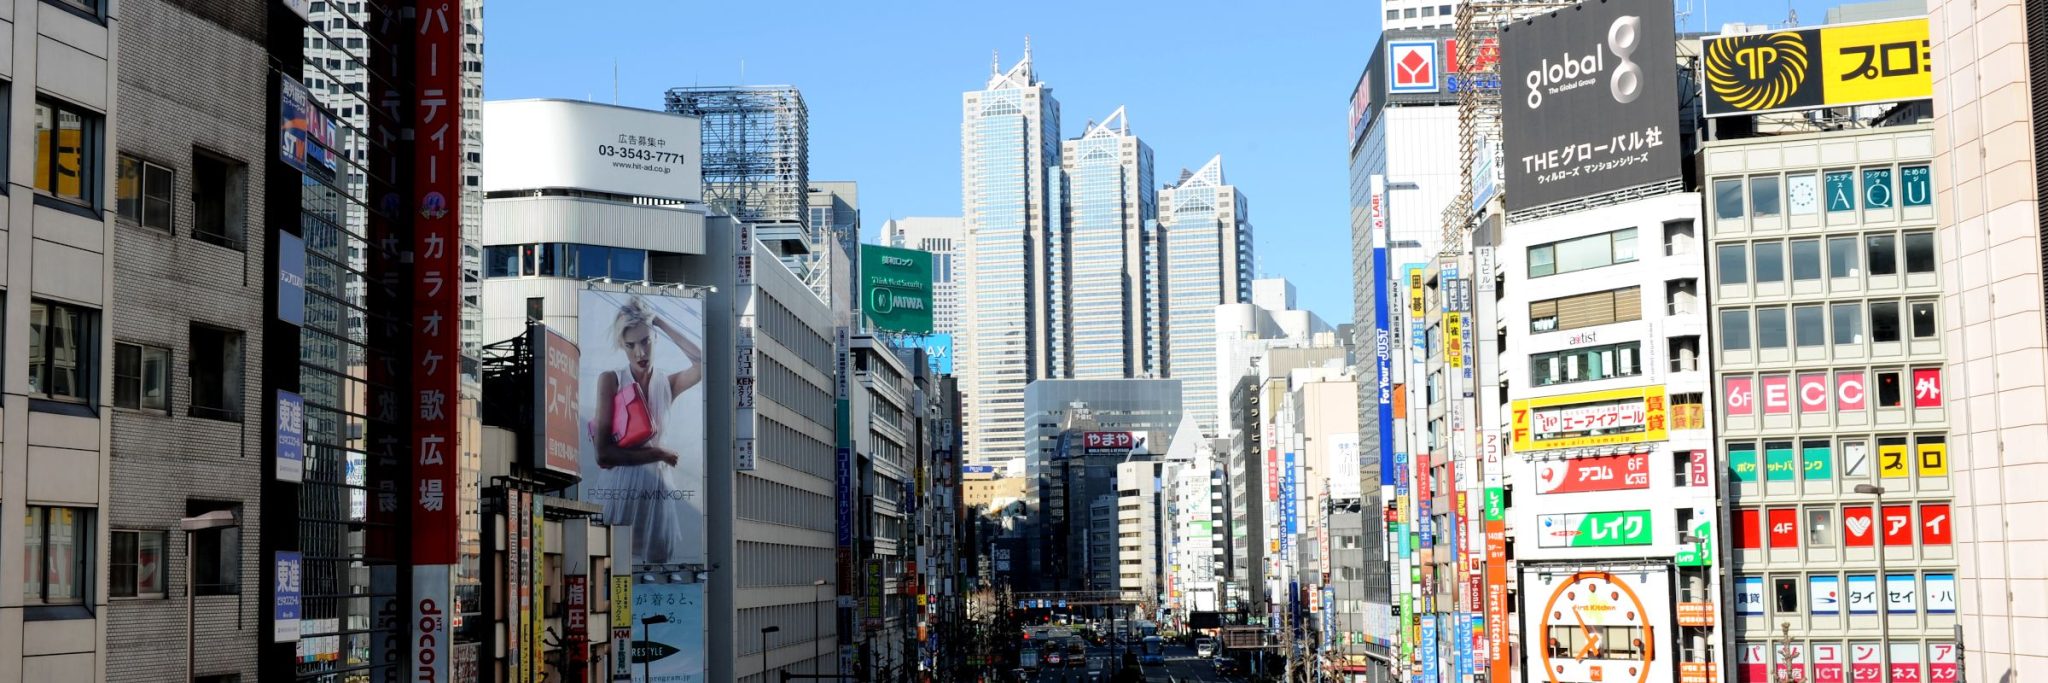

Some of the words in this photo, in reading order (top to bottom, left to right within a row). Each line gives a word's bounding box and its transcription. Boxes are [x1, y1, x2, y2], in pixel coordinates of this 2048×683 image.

[1526, 43, 1603, 109] global
[1548, 87, 1559, 95] The
[1560, 81, 1578, 92] Global
[1579, 78, 1597, 88] Group
[420, 3, 449, 184] パーティー
[618, 133, 666, 149] 広告募集中
[1522, 125, 1663, 174] THEグローバル社
[598, 144, 685, 165] 03-3543-7771
[612, 160, 671, 174] www.hit-ad.co.jp
[1538, 166, 1580, 184] ウィルローズ
[1584, 152, 1649, 175] マンションシリーズ
[1480, 248, 1491, 284] 村上ビル
[892, 295, 924, 310] MIWA
[420, 233, 449, 512] カラオケ歌広場
[736, 377, 754, 386] KEN
[1380, 366, 1389, 388] Your
[1380, 388, 1390, 404] For
[1728, 386, 1753, 407] 6F
[1915, 377, 1940, 400] 外
[279, 399, 301, 435] 東進
[1250, 384, 1261, 455] ホウライビル
[1563, 410, 1645, 431] エーアイアール
[1646, 395, 1665, 432] 賃貸
[1514, 410, 1528, 443] 7F
[1087, 433, 1130, 446] やまや
[1488, 434, 1497, 463] アコム
[1578, 465, 1614, 482] アコム
[1627, 458, 1643, 472] 6F
[1694, 452, 1706, 484] アコム
[1489, 491, 1500, 517] レイク
[1590, 515, 1643, 541] レイク
[1773, 522, 1793, 534] 4F
[277, 560, 299, 592] 東進
[567, 583, 585, 629] 指圧
[1489, 584, 1500, 613] First
[1590, 603, 1617, 612] Kitchen
[614, 629, 630, 639] KM
[1491, 614, 1502, 661] Kitchen
[632, 646, 663, 657] RESYLE
[1423, 628, 1435, 671] ソフマップ
[1591, 670, 1601, 678] FK
